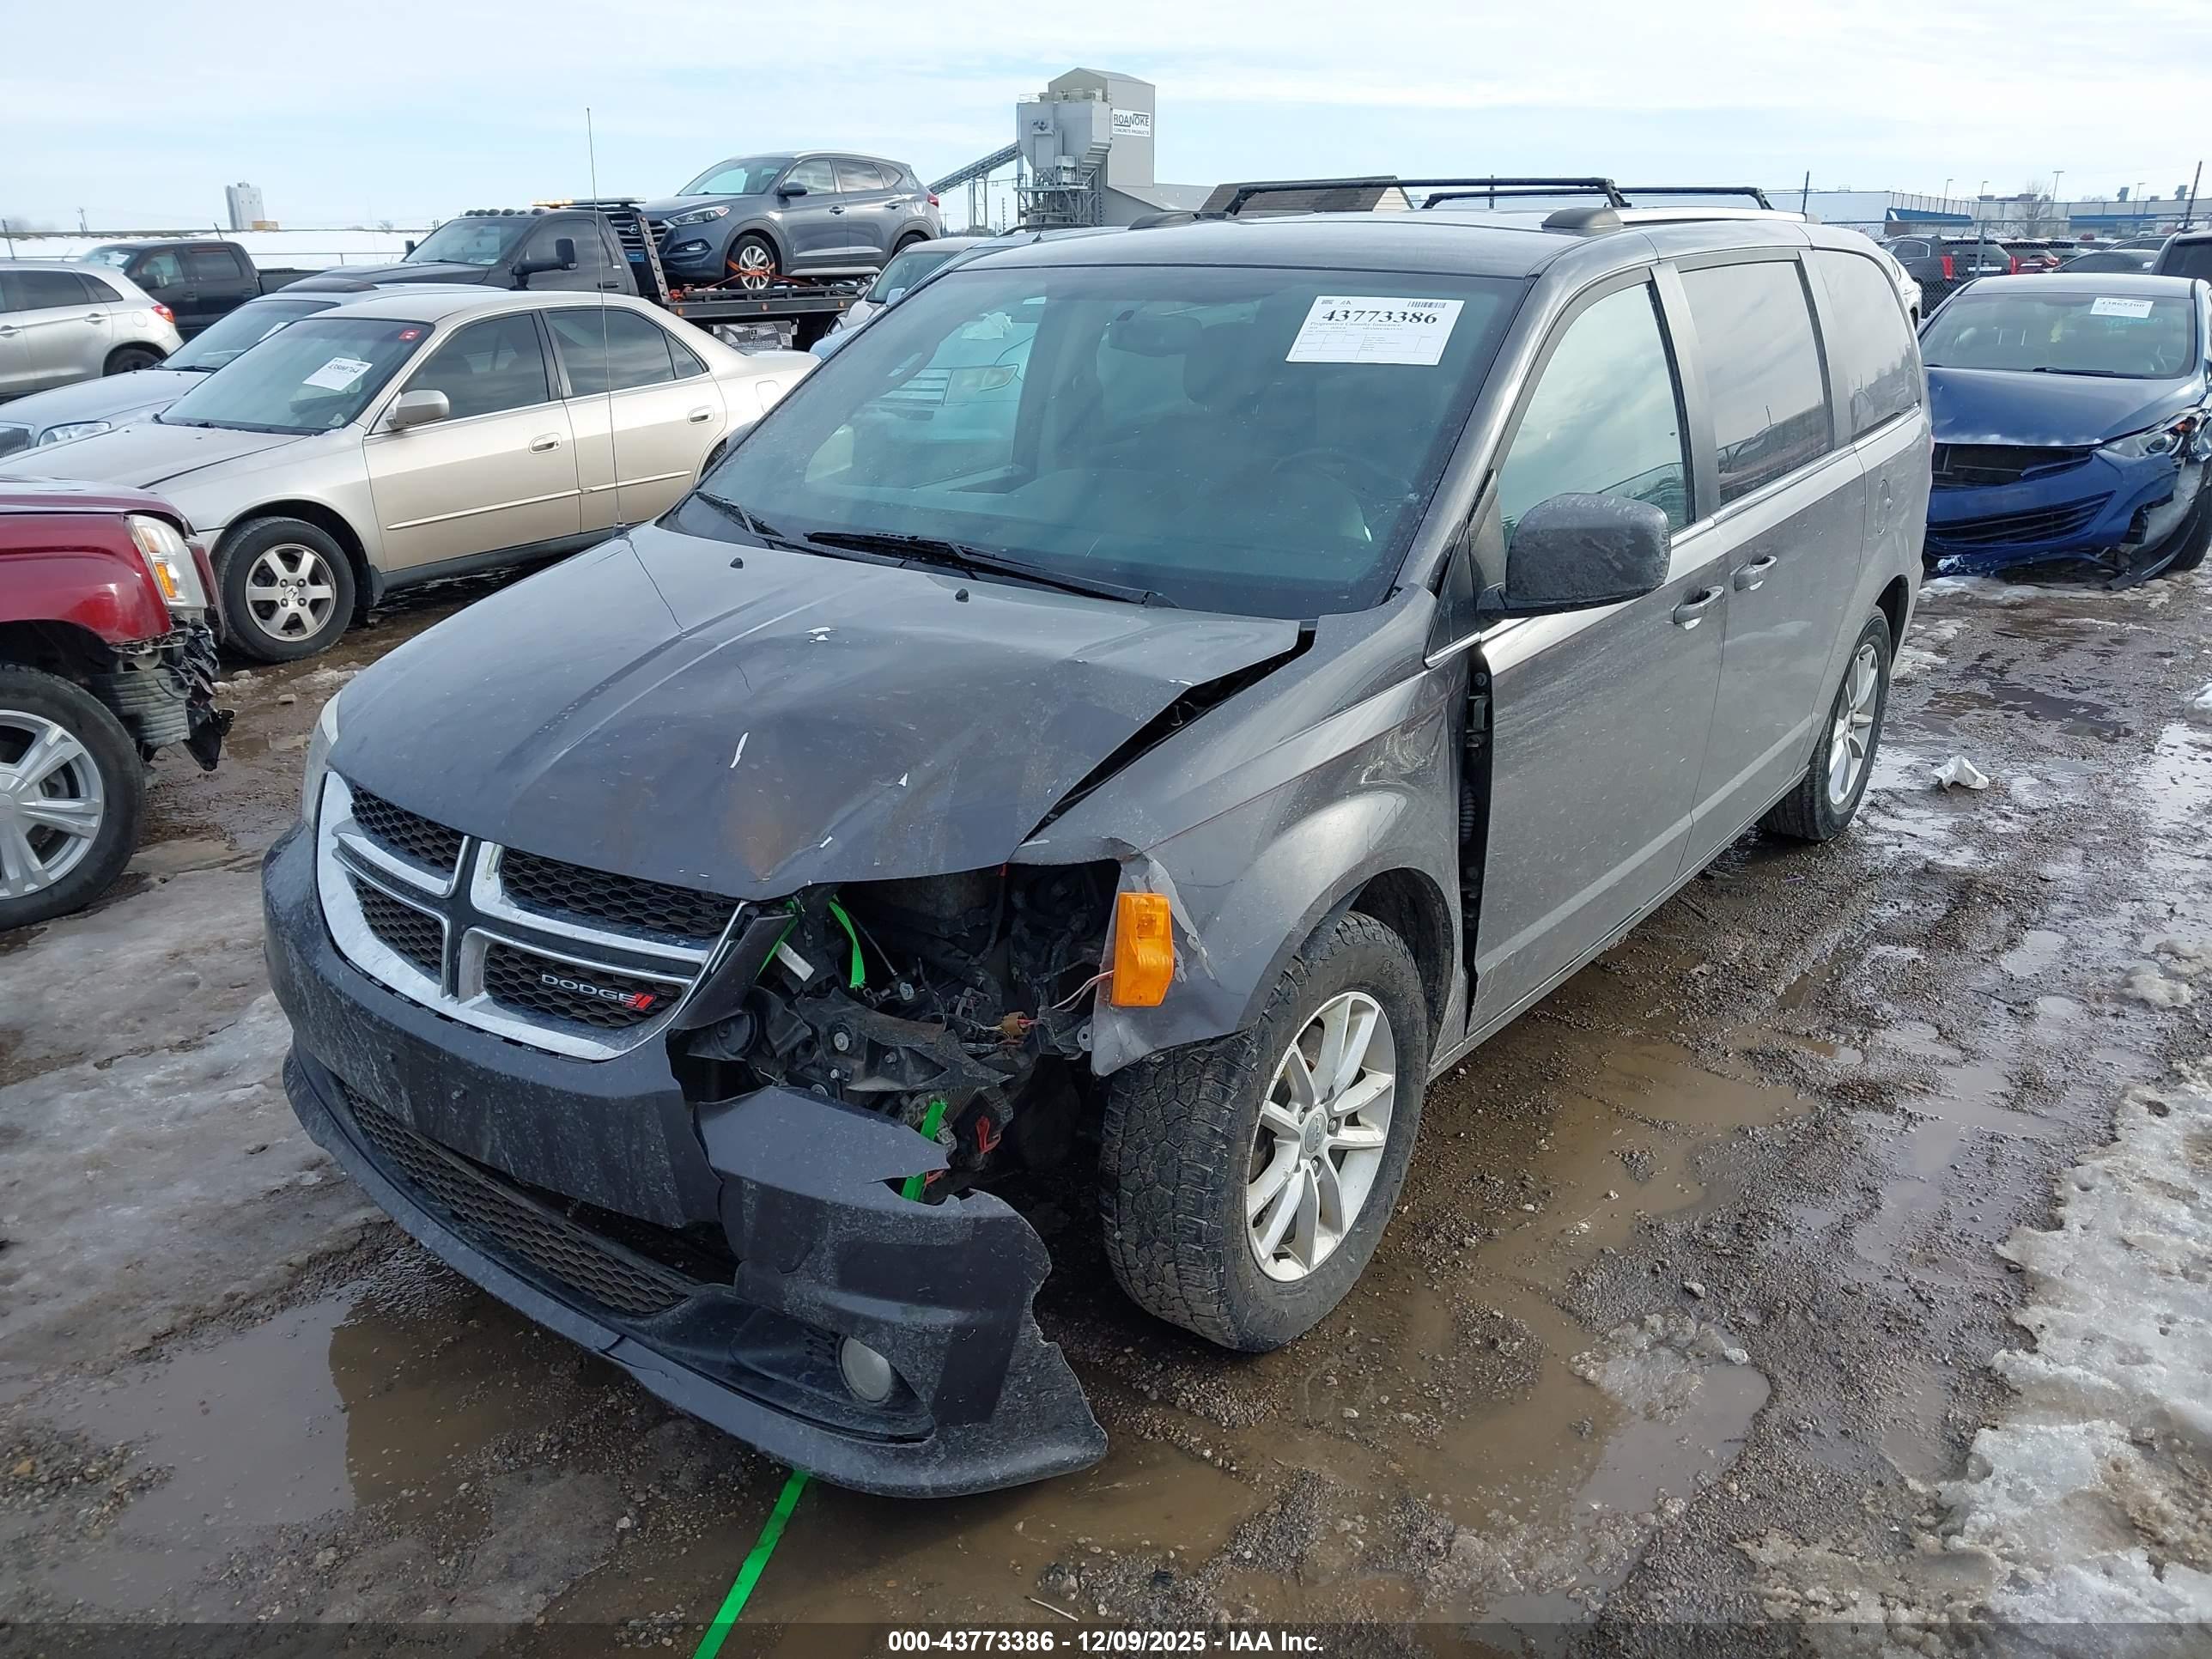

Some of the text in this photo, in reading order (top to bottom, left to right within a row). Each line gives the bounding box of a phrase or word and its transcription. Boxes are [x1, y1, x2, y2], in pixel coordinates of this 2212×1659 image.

[1114, 113, 1150, 127] ROANOKE
[1322, 309, 1441, 325] 43773386
[540, 974, 637, 1005] DODGE
